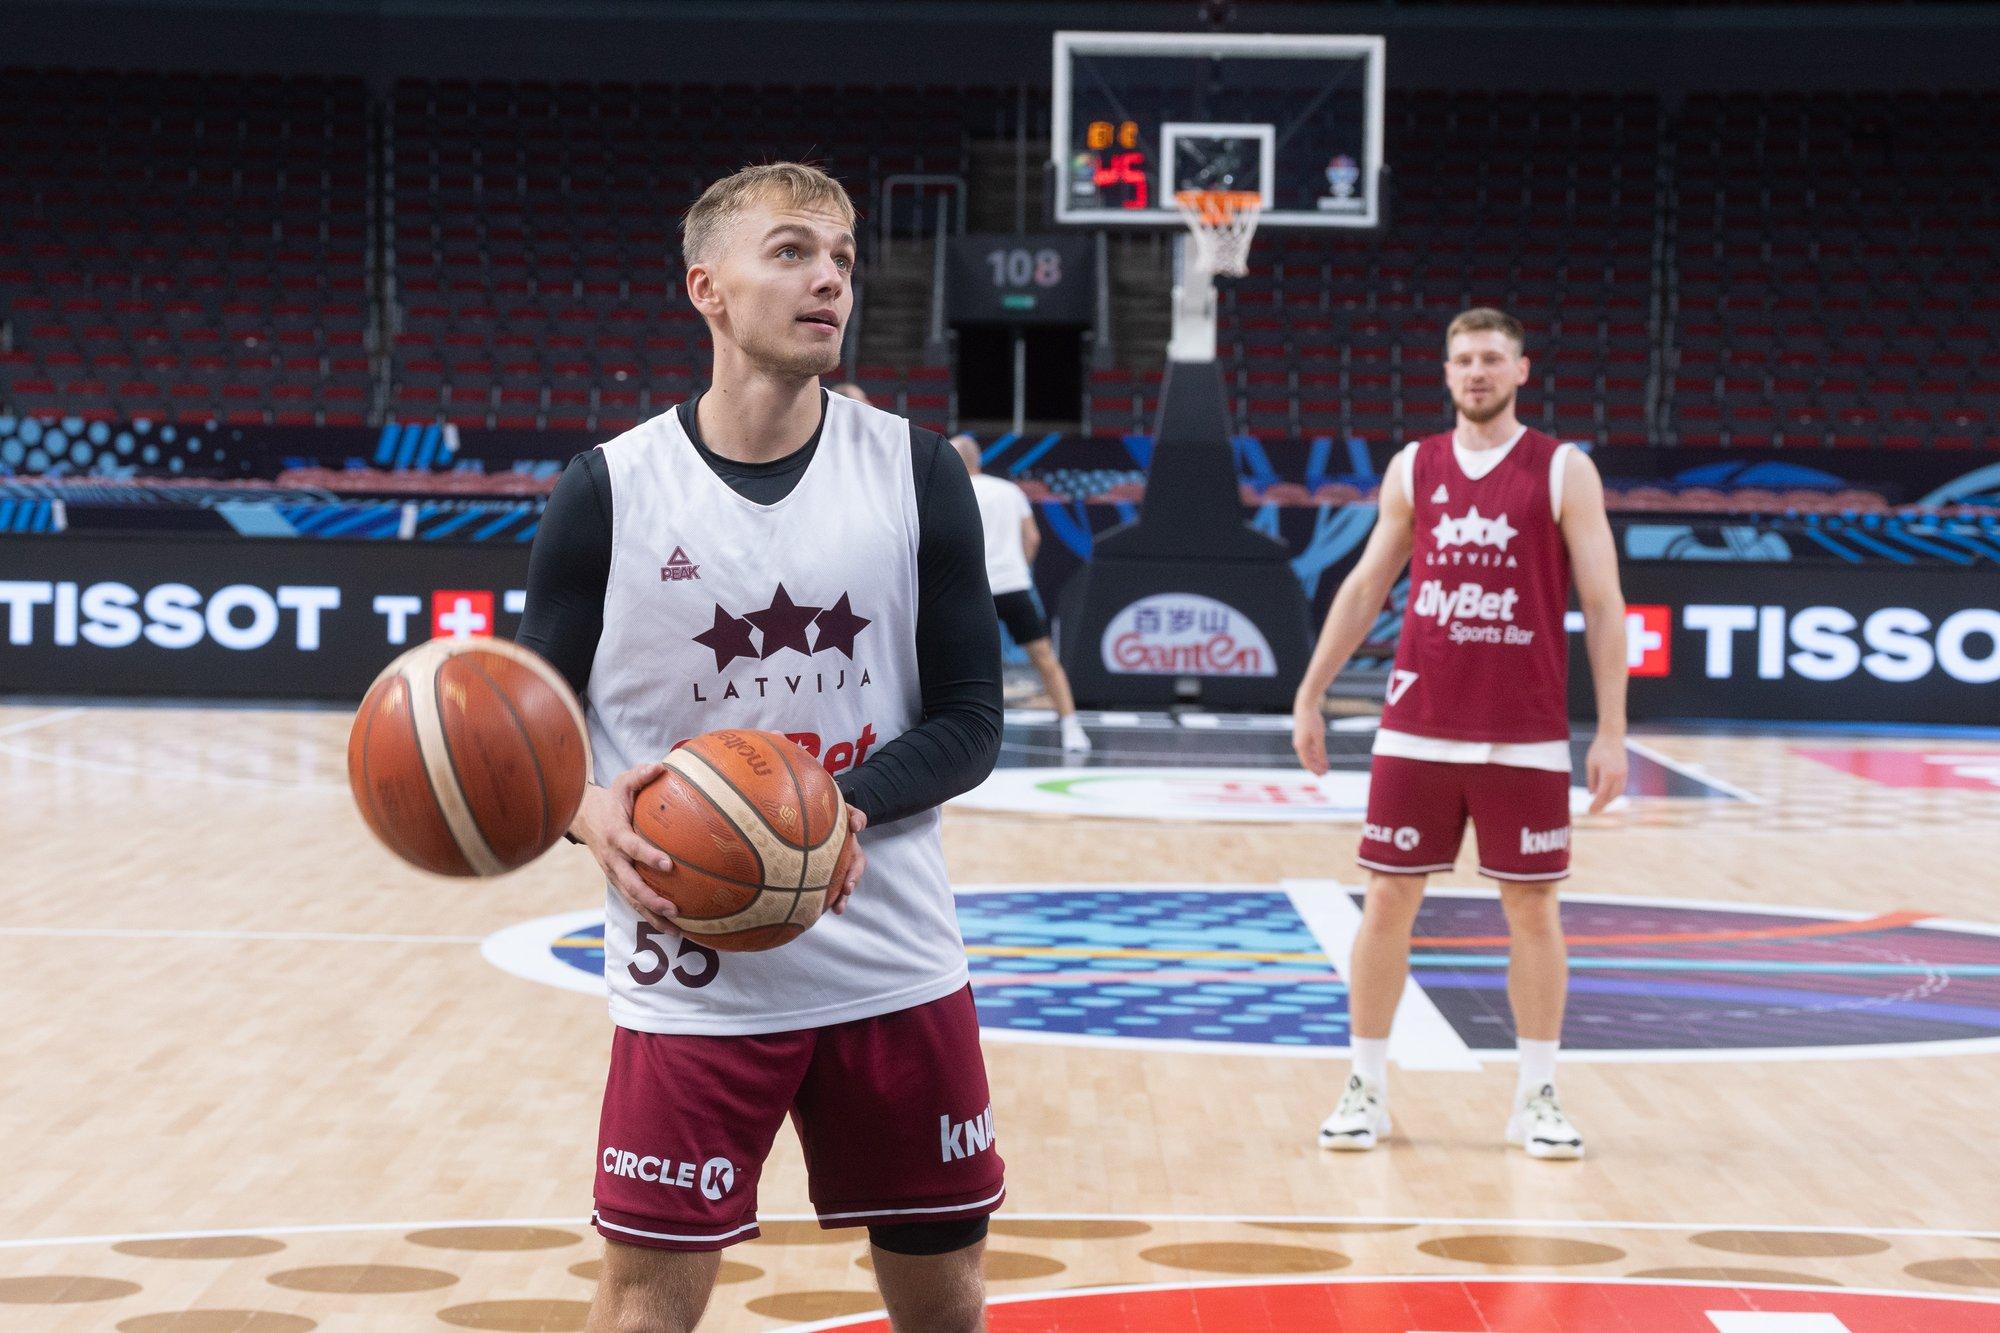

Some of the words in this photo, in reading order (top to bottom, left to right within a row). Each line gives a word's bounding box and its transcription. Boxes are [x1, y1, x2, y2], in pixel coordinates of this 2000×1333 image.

[987, 250, 1062, 286] 108
[660, 564, 700, 582] PEAK
[1425, 551, 1518, 568] LATVIJA
[0, 580, 341, 651] TISSOT
[1414, 579, 1519, 627] OlyBet
[1448, 621, 1502, 645] Sports
[1504, 624, 1535, 646] Bar
[693, 668, 871, 702] LATVIJA
[627, 921, 720, 988] 55
[603, 1147, 697, 1188] CIRCLE
[702, 1158, 734, 1200] K
